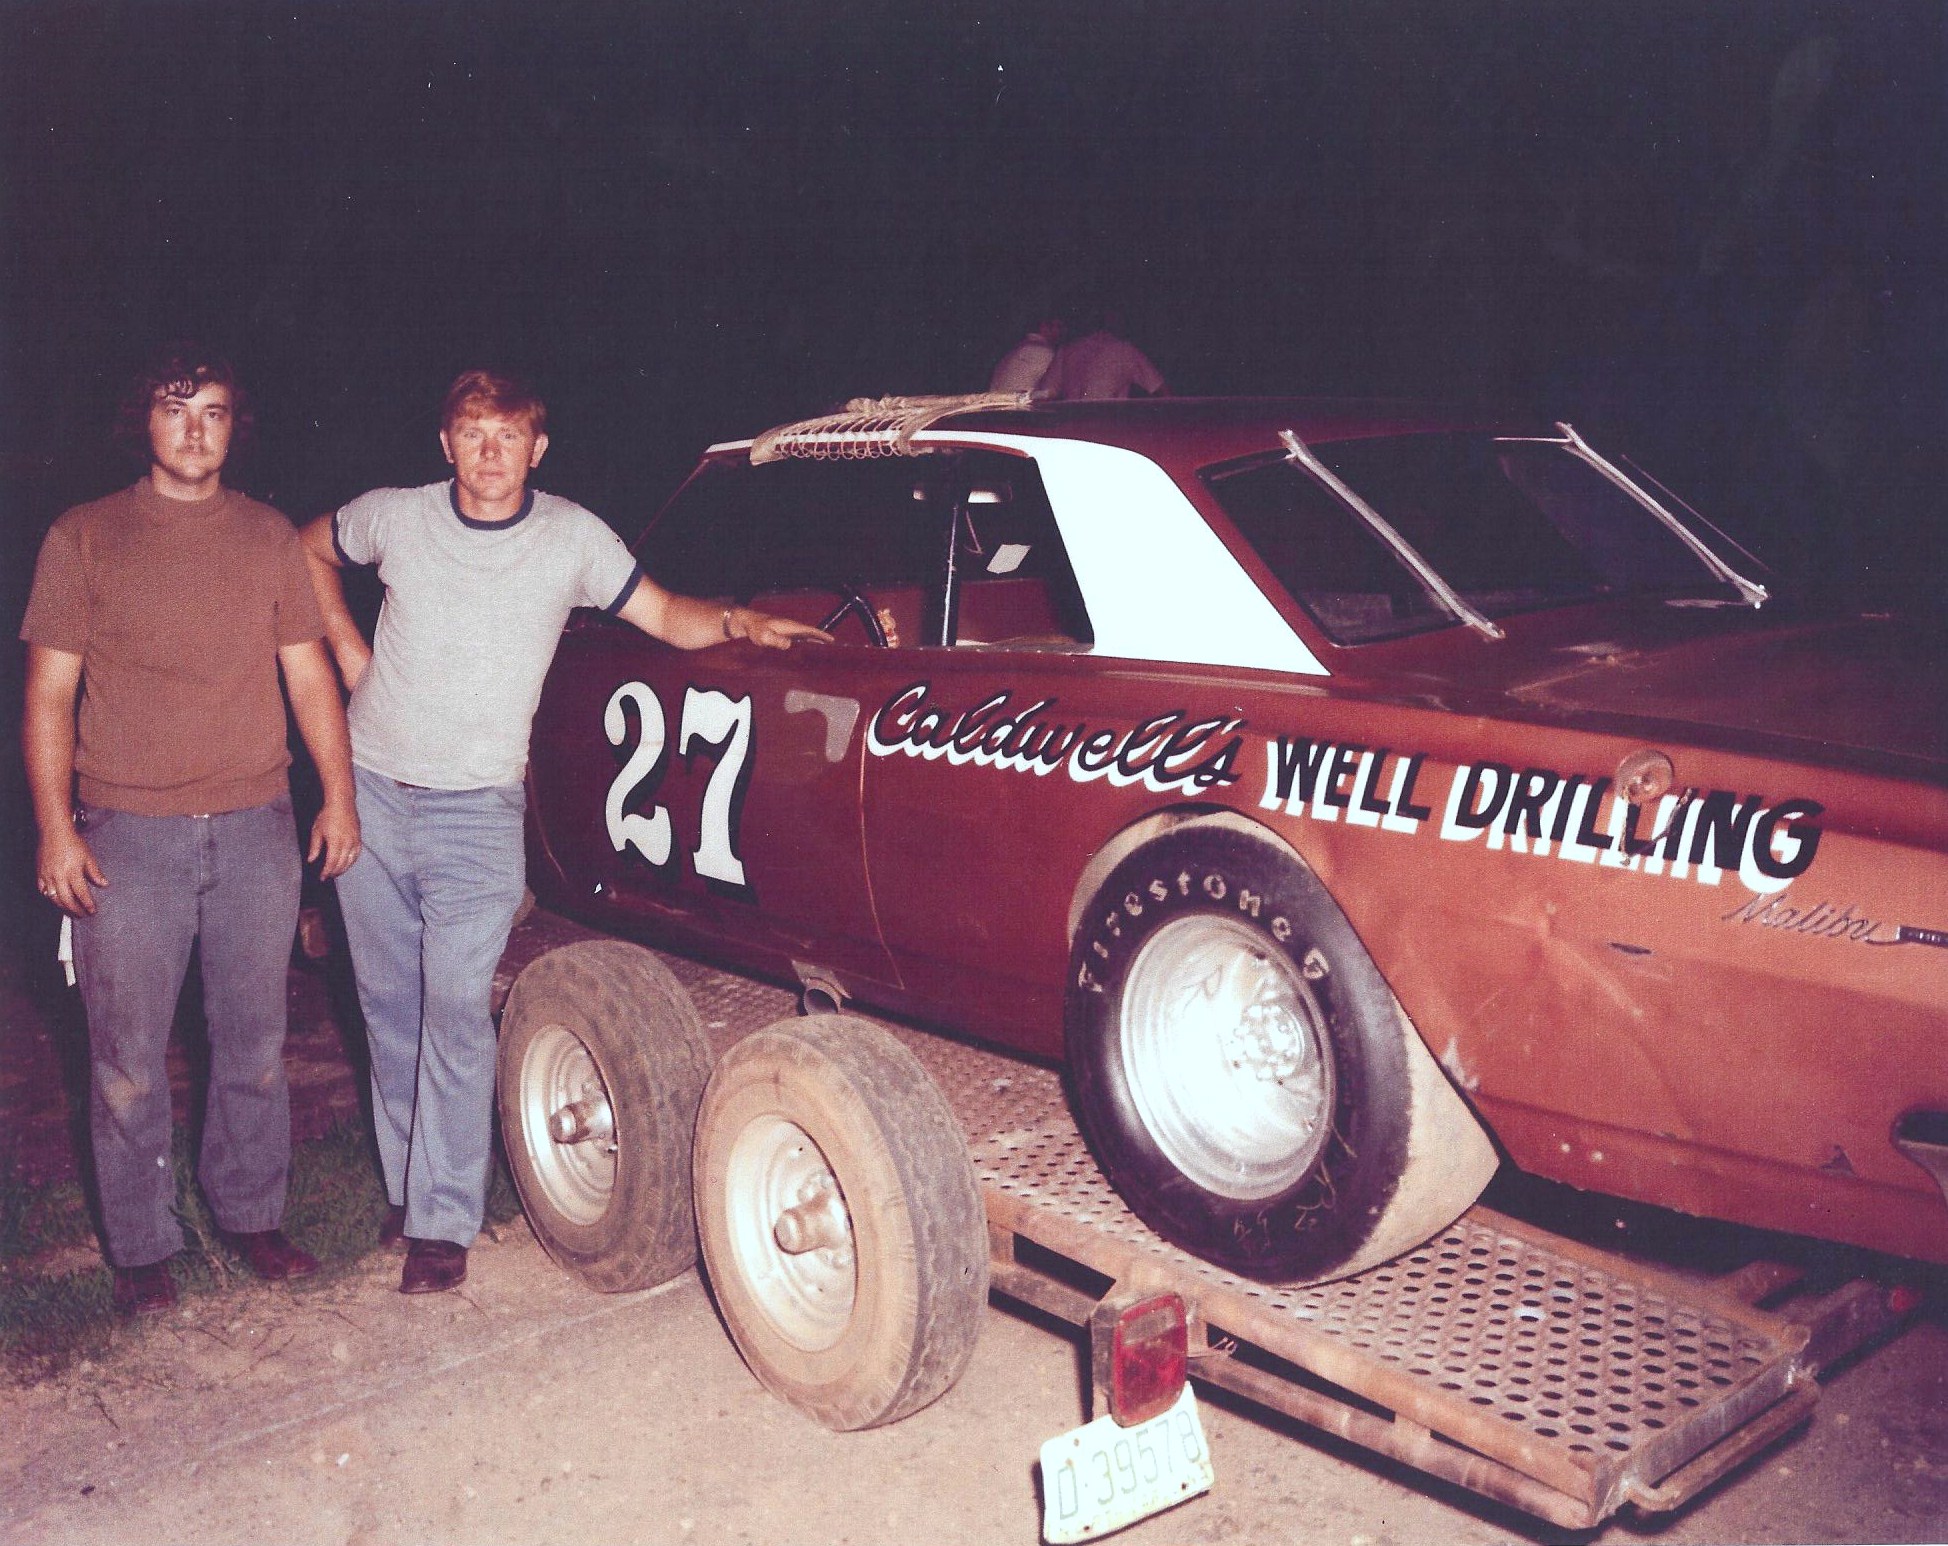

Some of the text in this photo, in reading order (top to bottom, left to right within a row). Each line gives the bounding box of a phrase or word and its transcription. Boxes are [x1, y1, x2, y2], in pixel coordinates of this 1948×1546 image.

[603, 681, 756, 892] 27
[866, 683, 1826, 894] Caldwell's WELL DRILLING
[1077, 870, 1293, 993] Firestone
[1721, 893, 1882, 940] Malibu
